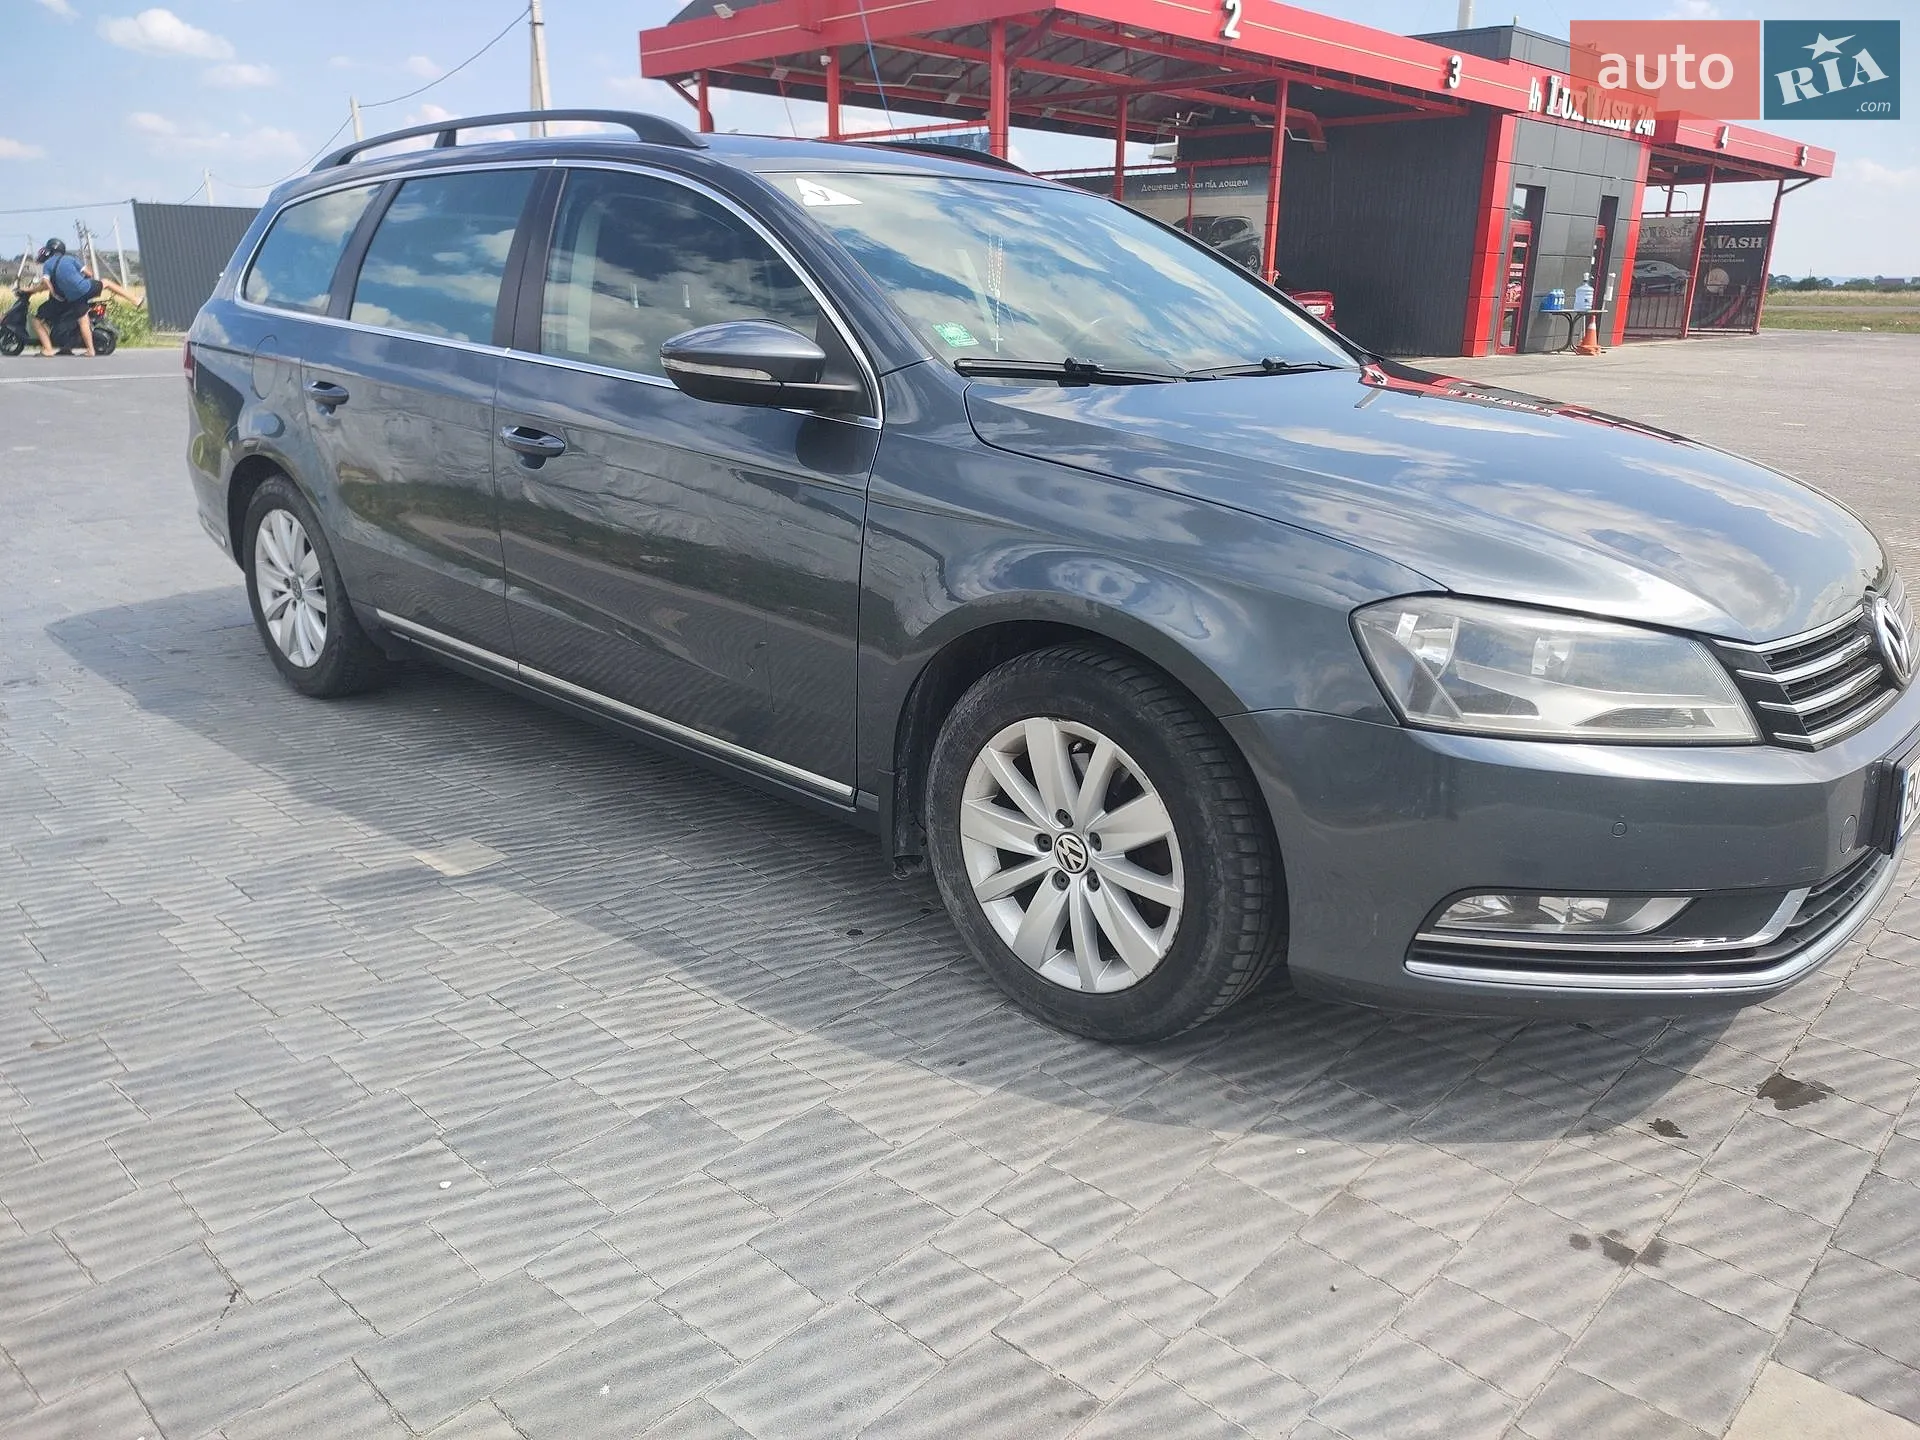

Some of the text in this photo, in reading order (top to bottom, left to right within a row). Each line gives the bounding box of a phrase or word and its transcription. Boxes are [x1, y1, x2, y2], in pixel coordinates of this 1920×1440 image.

[1224, 0, 1241, 39] 2
[1448, 54, 1463, 89] 3
[1709, 235, 1763, 249] WASH
